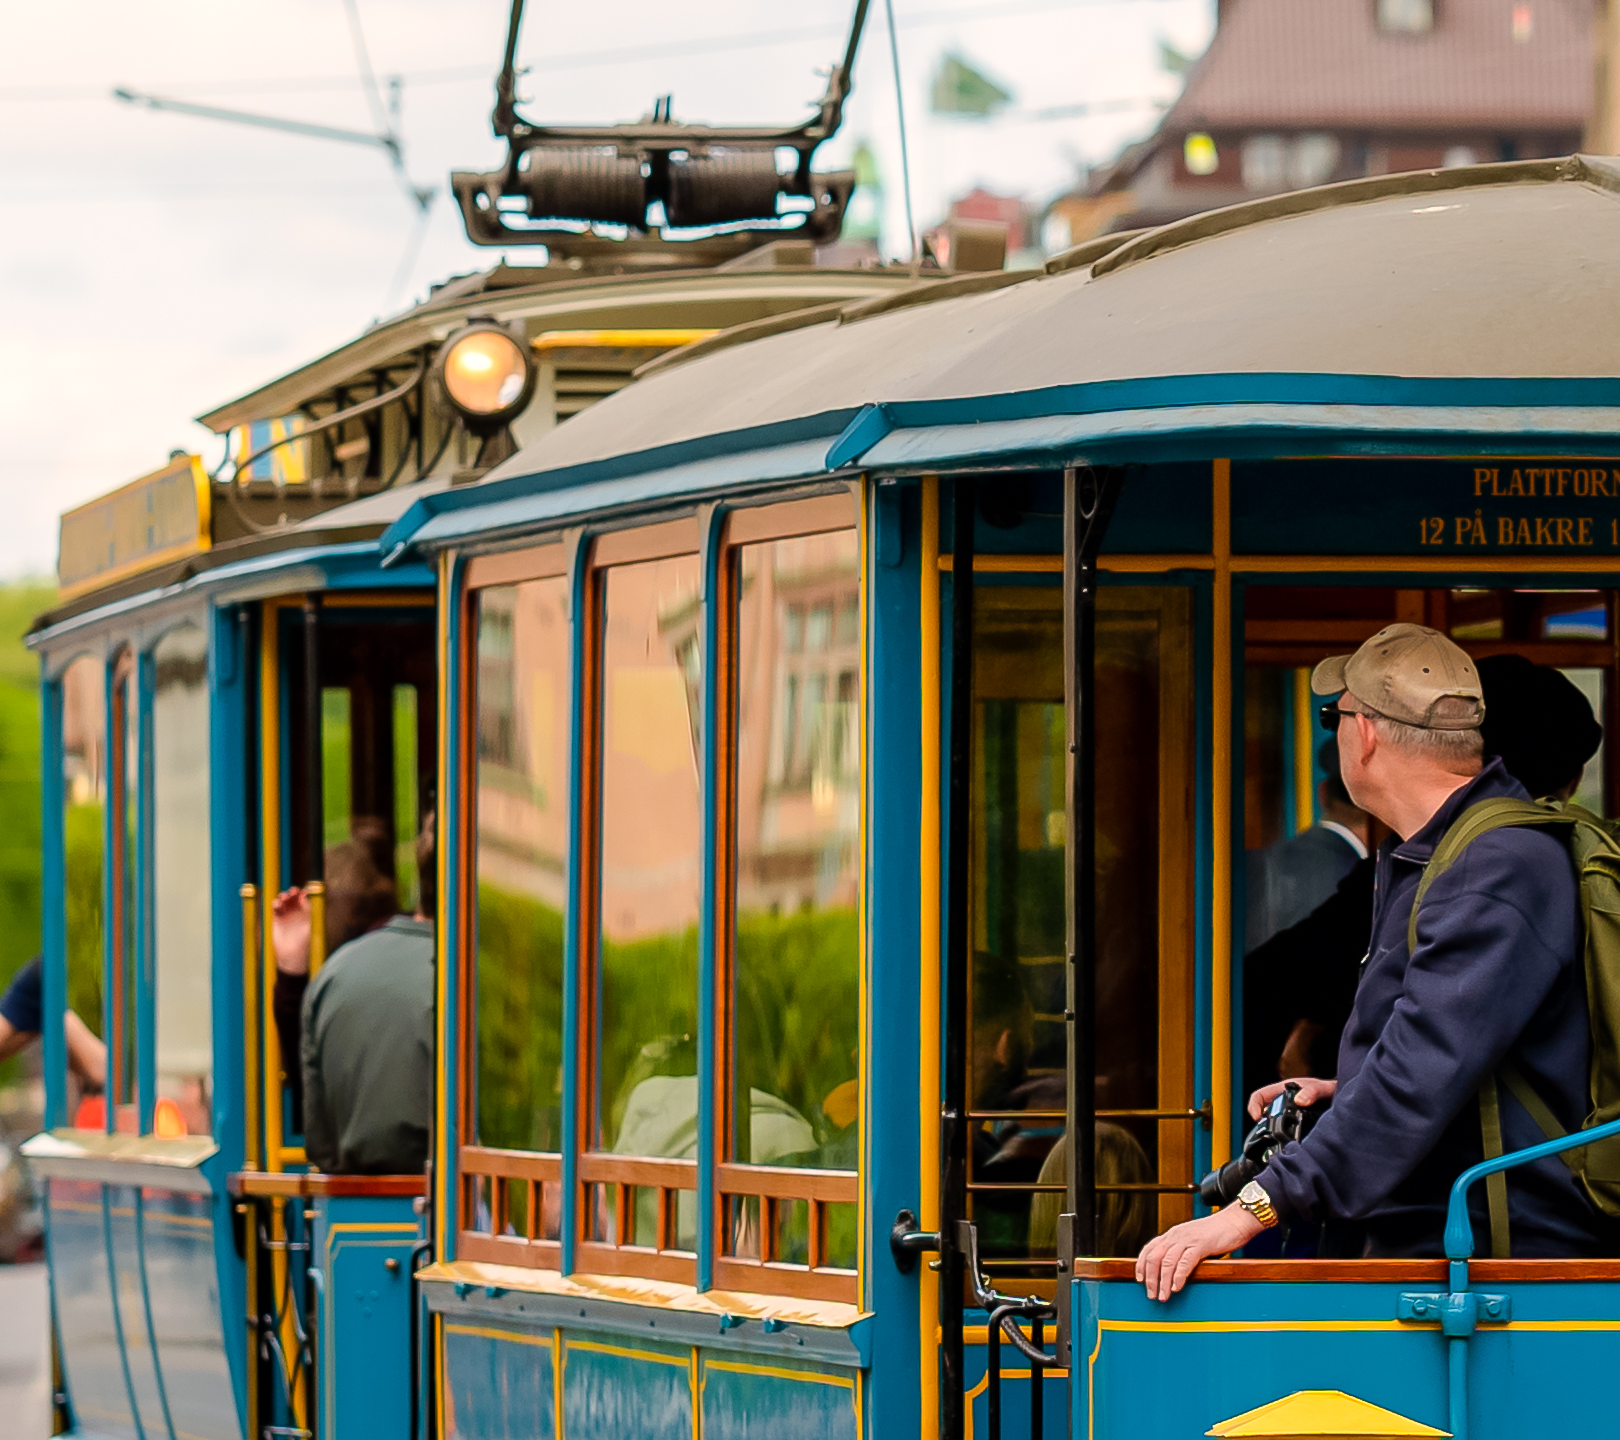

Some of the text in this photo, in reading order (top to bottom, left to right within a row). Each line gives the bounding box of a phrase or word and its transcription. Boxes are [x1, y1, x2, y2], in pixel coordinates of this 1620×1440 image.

[1420, 516, 1445, 546] 12
[1454, 508, 1488, 546] PÅ
[1497, 517, 1594, 546] BAKRE
